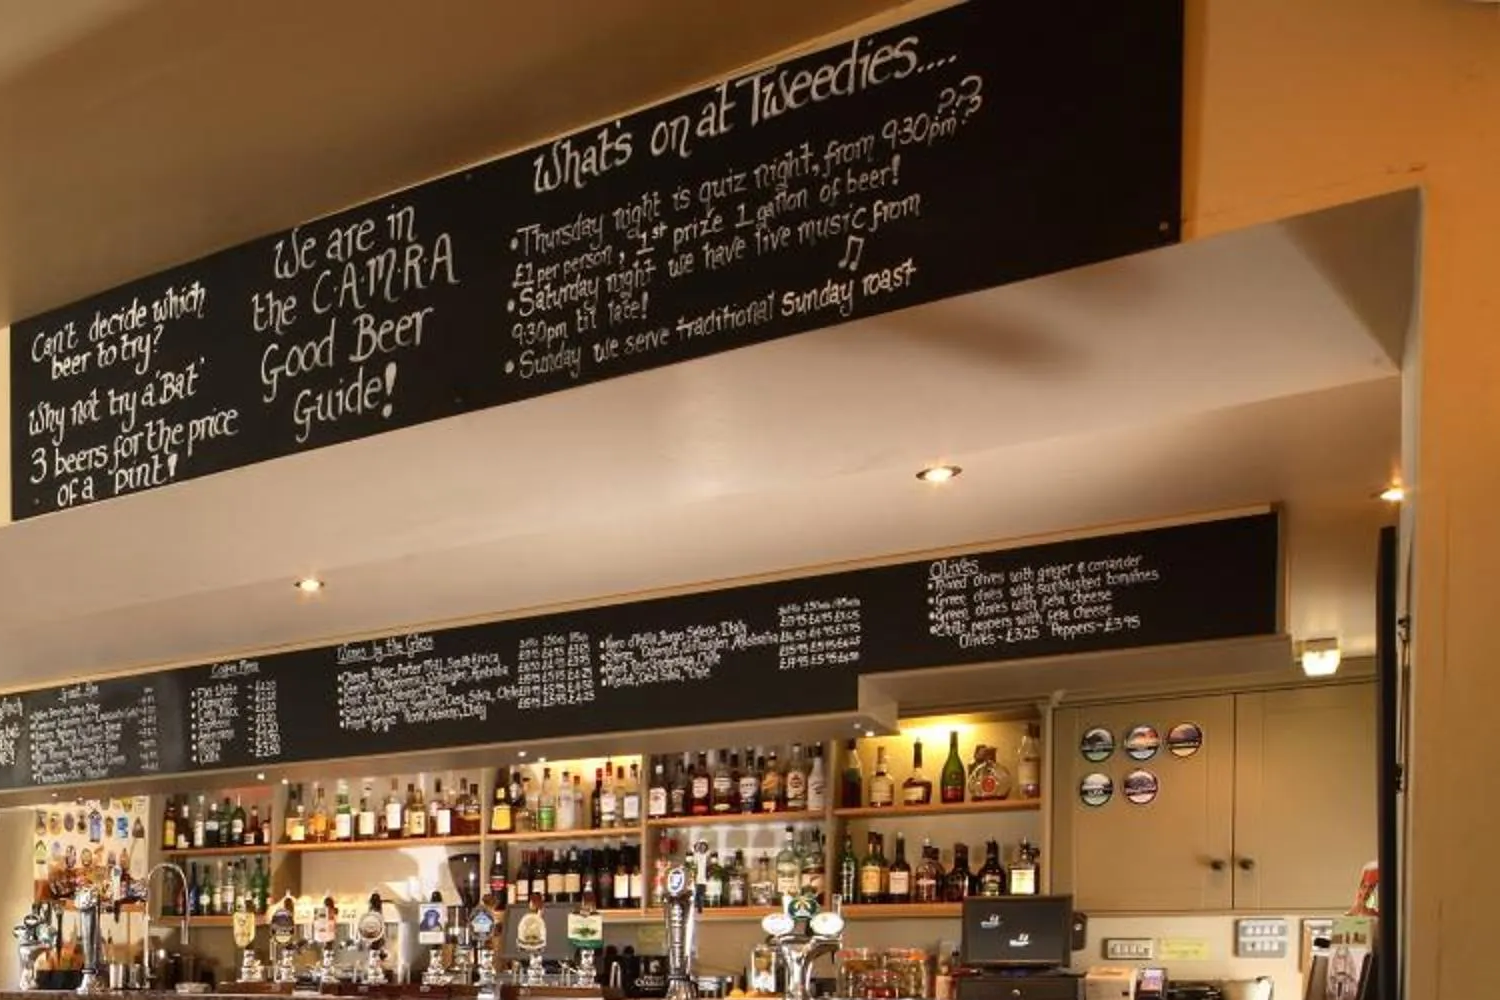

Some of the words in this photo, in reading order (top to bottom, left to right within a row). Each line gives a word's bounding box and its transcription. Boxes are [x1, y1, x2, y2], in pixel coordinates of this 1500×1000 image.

[651, 115, 692, 158] on
[695, 81, 737, 137] at
[512, 262, 534, 288] £1
[537, 263, 560, 287] per
[636, 221, 667, 255] 1st
[673, 213, 723, 252] prize
[735, 203, 754, 228] 1
[757, 186, 807, 231] gallon
[820, 177, 840, 202] of
[848, 154, 900, 193] beer!
[516, 212, 604, 256] Thursday
[612, 191, 662, 238] night
[672, 186, 691, 211] is
[699, 168, 747, 214] quiz
[754, 142, 820, 192] night,
[823, 135, 875, 177] from
[274, 227, 316, 279] We
[325, 218, 375, 262] are
[387, 204, 416, 243] in
[520, 273, 599, 316] Saturday
[606, 259, 656, 298] night
[668, 253, 693, 278] we
[702, 237, 746, 269] have
[756, 225, 791, 255] live
[798, 205, 867, 244] music
[869, 193, 920, 232] from
[89, 297, 147, 341] decide
[151, 280, 206, 319] which
[252, 290, 297, 336] the
[520, 342, 581, 378] Sunday
[593, 337, 619, 363] we
[624, 327, 670, 353] serve
[676, 290, 775, 340] traditional
[781, 279, 854, 317] Sunday
[862, 258, 916, 296] roast
[608, 292, 649, 324] late!
[51, 351, 91, 380] beer
[97, 340, 117, 368] to
[121, 324, 164, 375] try?
[261, 317, 336, 403] Good
[349, 306, 435, 363] Beer
[29, 401, 65, 446] Why
[71, 388, 100, 425] not
[108, 389, 137, 433] try
[141, 383, 155, 407] a
[293, 361, 397, 443] Guide!
[30, 447, 47, 483] 3
[55, 445, 108, 477] beers
[108, 432, 145, 475] for
[145, 419, 184, 455] the
[188, 407, 239, 457] price
[57, 478, 78, 507] of
[81, 476, 94, 500] a
[115, 453, 178, 494] pint!
